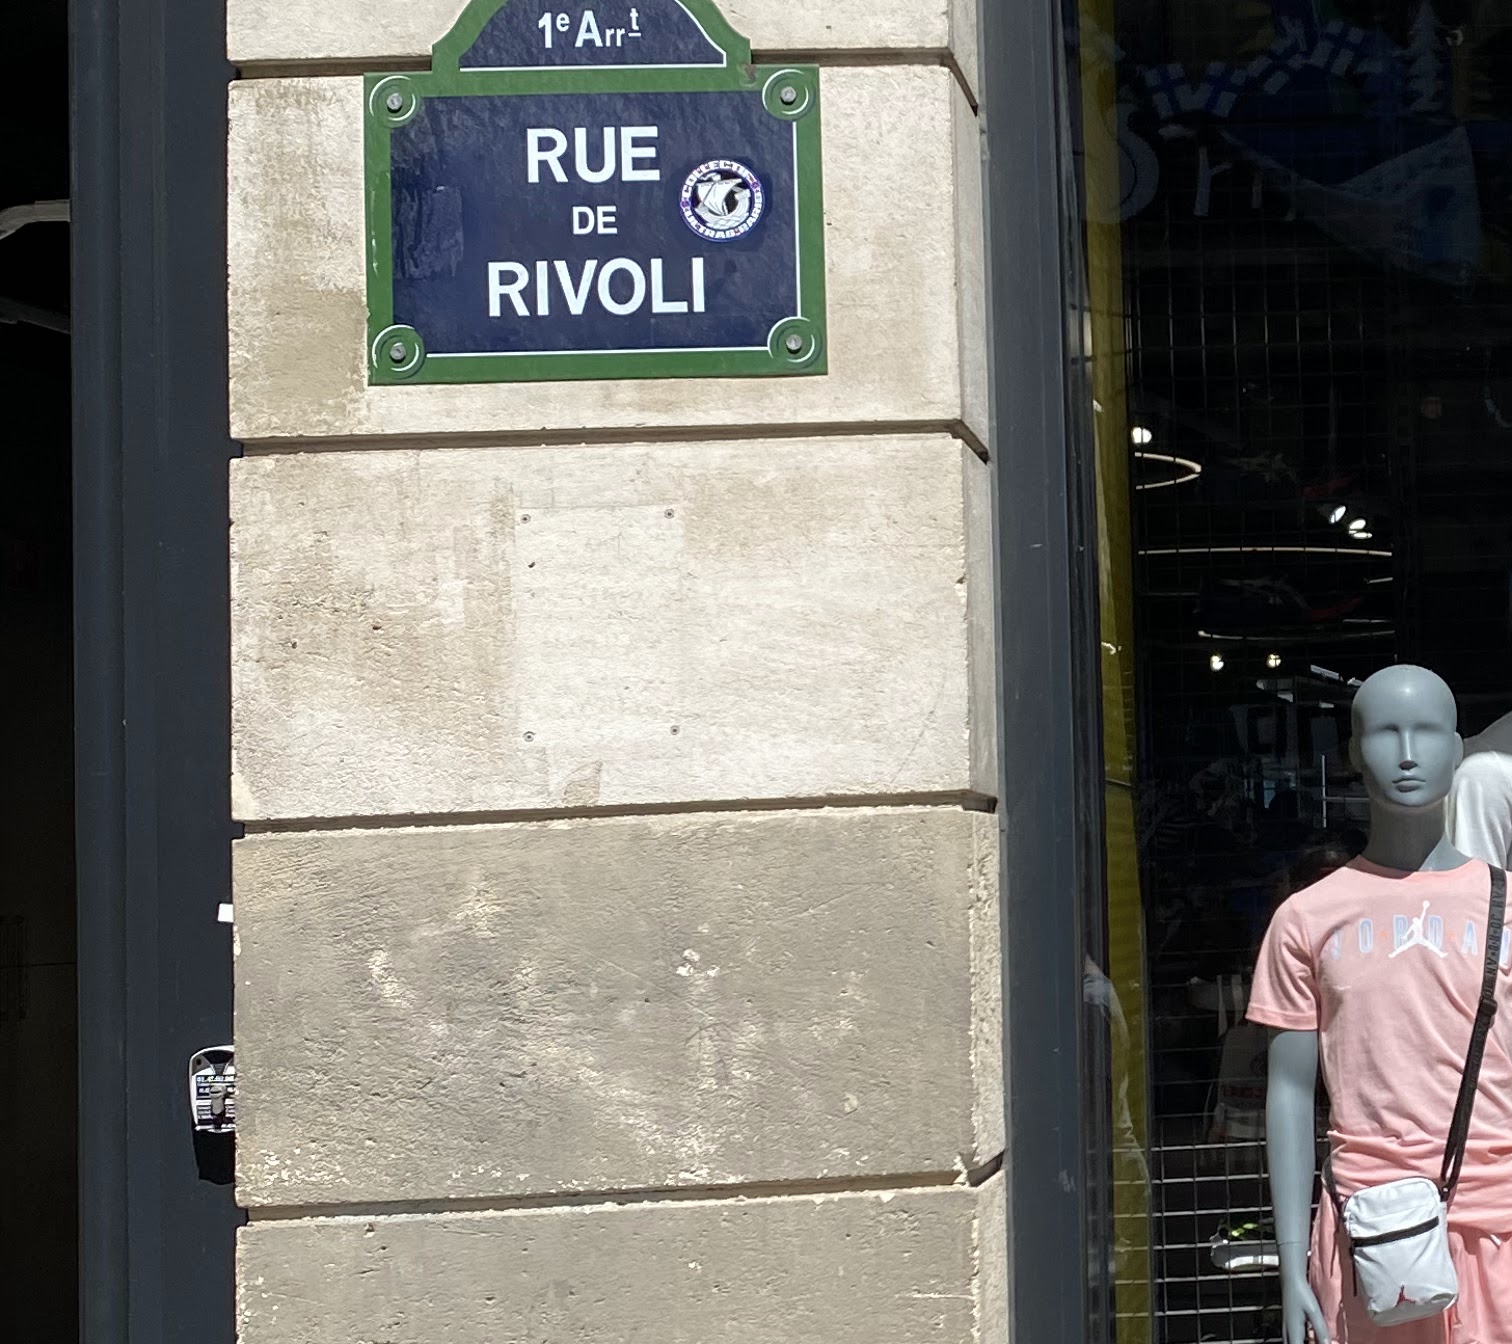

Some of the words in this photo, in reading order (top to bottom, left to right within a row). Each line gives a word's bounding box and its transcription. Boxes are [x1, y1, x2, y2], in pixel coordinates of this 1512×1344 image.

[526, 125, 661, 184] RUE
[571, 205, 618, 235] DE
[487, 256, 706, 318] RIVOLI
